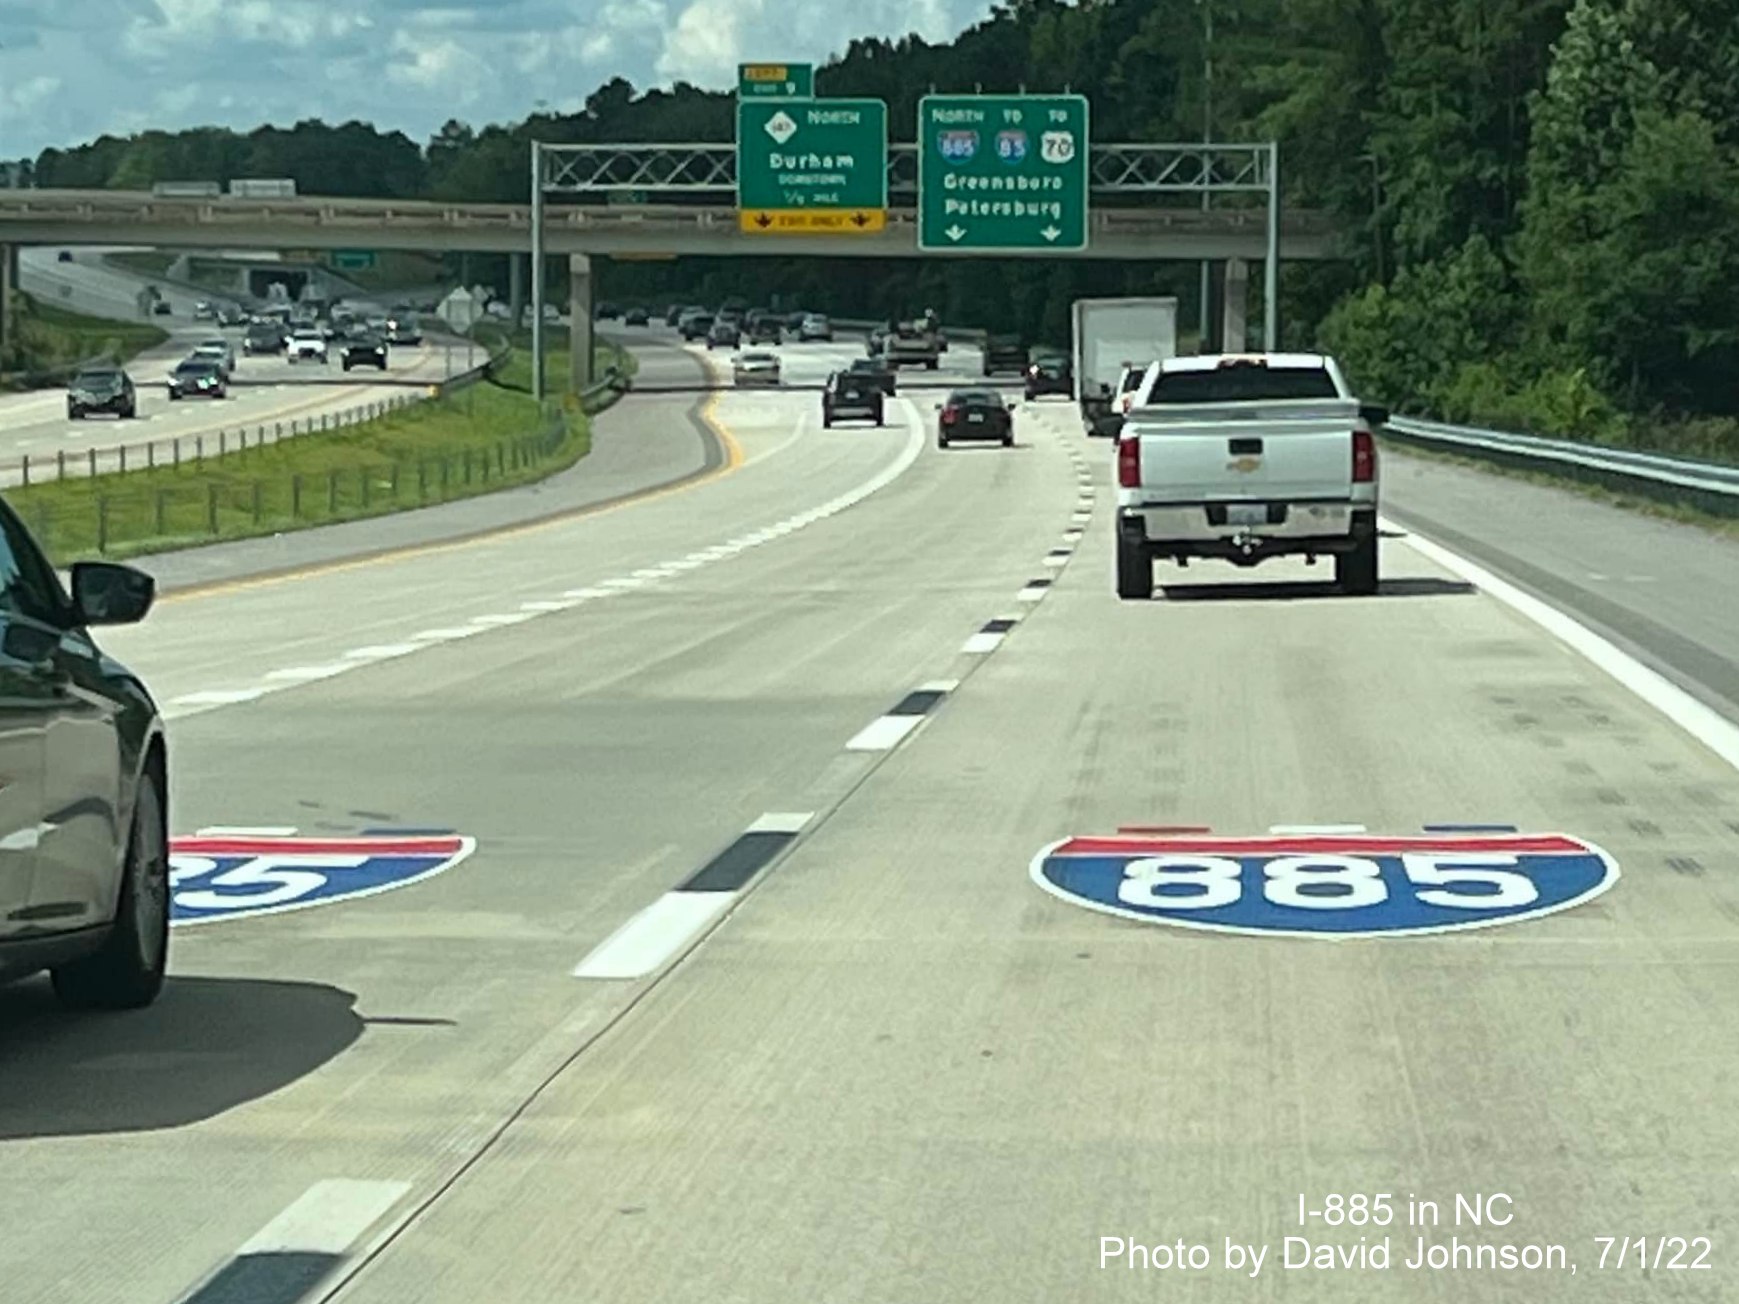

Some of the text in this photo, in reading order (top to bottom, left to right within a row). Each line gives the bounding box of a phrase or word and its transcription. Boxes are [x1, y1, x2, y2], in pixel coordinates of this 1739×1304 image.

[808, 111, 860, 124] NORTH
[931, 109, 1068, 123] NORTH TO TO
[941, 139, 1072, 157] 885 85 70
[769, 152, 855, 170] Durham
[778, 174, 847, 186] DOWNTOWN
[943, 171, 1063, 190] Greensboro
[944, 199, 1061, 220] Petersburg
[1117, 854, 1539, 909] 885
